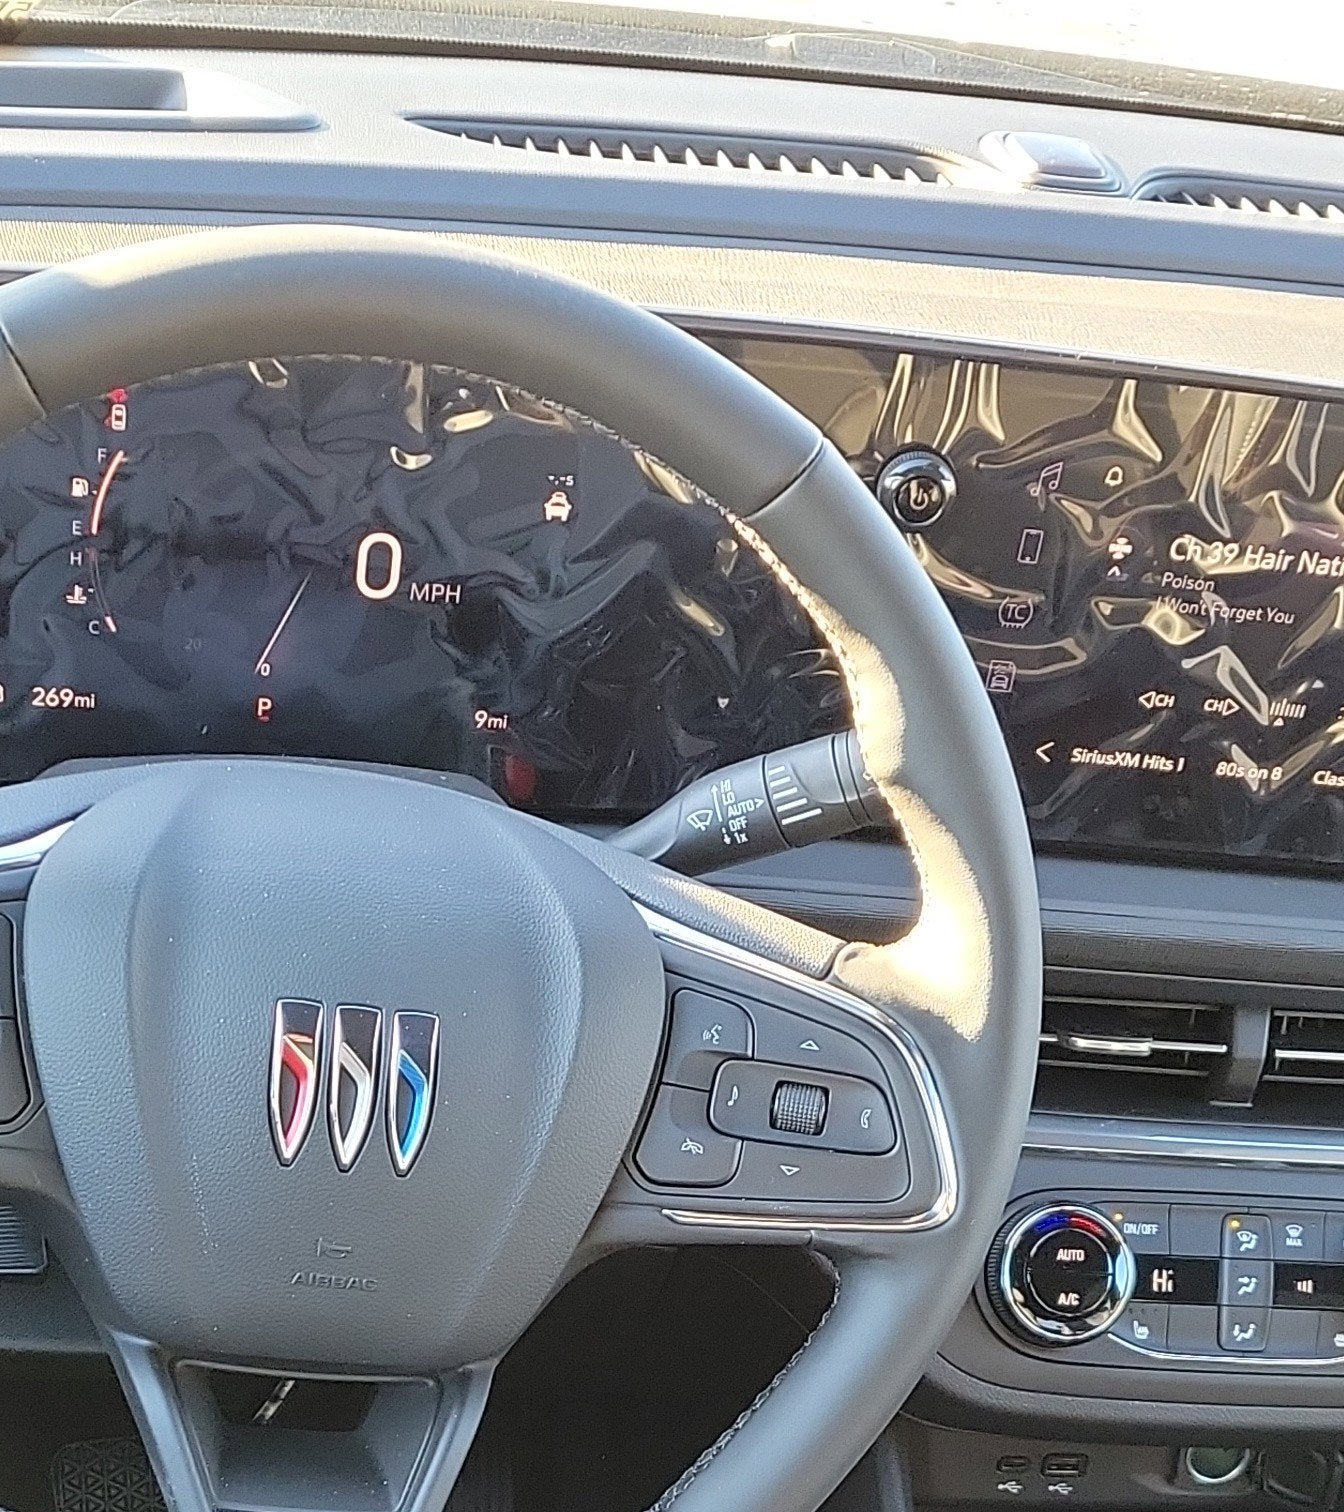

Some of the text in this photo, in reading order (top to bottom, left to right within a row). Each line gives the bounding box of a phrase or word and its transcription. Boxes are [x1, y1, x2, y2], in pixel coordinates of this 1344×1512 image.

[97, 448, 107, 463] F
[72, 520, 82, 536] E
[70, 551, 82, 566] H
[1169, 537, 1202, 562] Ch
[1206, 540, 1240, 564] 39
[1243, 545, 1296, 573] Hair
[356, 532, 462, 604] 0 MPH
[1161, 571, 1216, 592] Poison
[1164, 597, 1207, 616] Won't
[1212, 604, 1264, 625] Forget
[1266, 606, 1296, 625] You
[88, 620, 100, 635] C
[260, 663, 271, 676] 0
[257, 697, 272, 717] P
[1155, 694, 1175, 708] CH
[1203, 699, 1224, 713] CH
[1070, 748, 1140, 769] SiriusXM
[1141, 755, 1174, 772] Hits
[1215, 762, 1245, 777] 80s
[1270, 766, 1283, 780] 8
[720, 778, 732, 794] HI
[721, 792, 736, 806] LO
[727, 800, 757, 818] AUTO
[728, 817, 749, 832] OFF
[1123, 1222, 1160, 1236] ON/OFF
[1056, 1249, 1086, 1262] AUTO
[290, 1271, 380, 1292] AIRBAG
[1058, 1291, 1080, 1306] A/C
